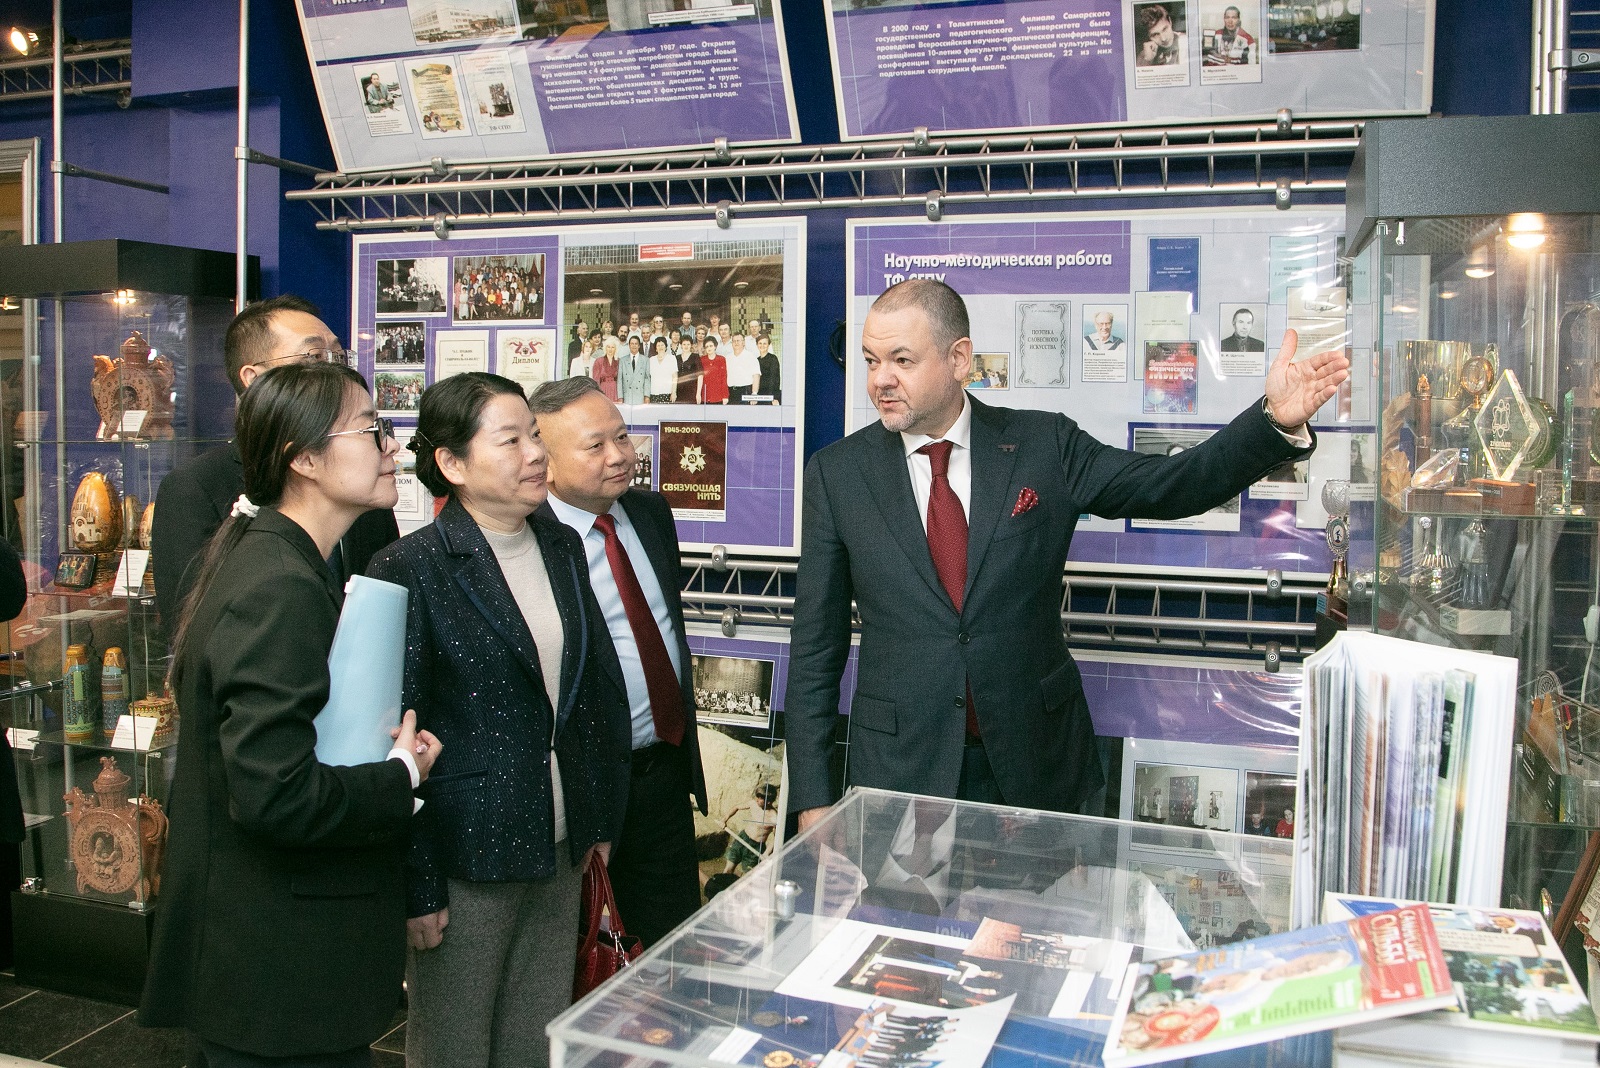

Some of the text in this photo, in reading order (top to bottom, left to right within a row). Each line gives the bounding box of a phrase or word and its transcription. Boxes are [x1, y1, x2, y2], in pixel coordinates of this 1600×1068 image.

[949, 18, 1004, 27] Тольяттинском
[1020, 14, 1055, 24] филиале
[1063, 11, 1110, 20] Самарского
[876, 32, 940, 42] государственного
[949, 27, 1012, 37] педагогического
[1027, 22, 1080, 32] университета
[627, 46, 656, 55] декабре
[702, 40, 736, 48] Открытие
[876, 29, 1111, 52] проведена Всероссийская научно-практическая конференция,
[964, 46, 1006, 55] факультета
[1012, 42, 1056, 52] физической
[1059, 40, 1098, 48] культуры.
[540, 62, 587, 70] гуманитарного
[638, 52, 683, 62] потребностям
[554, 70, 587, 78] начинался
[600, 66, 640, 74] факультетов
[650, 60, 692, 70] дошкольной
[694, 58, 731, 66] педагогики
[878, 60, 929, 69] конференции
[936, 57, 976, 65] выступили
[1001, 52, 1055, 62] докладчиков,
[544, 78, 582, 86] психологии,
[589, 76, 618, 84] русского
[662, 68, 704, 76] литературы,
[710, 66, 739, 74] физико-
[880, 64, 1006, 78] подготовили сотрудники филиала.
[546, 86, 602, 94] математического,
[606, 80, 665, 90] общетехнических
[669, 76, 706, 85] дисциплин
[718, 74, 740, 82] труда.
[547, 94, 584, 102] Постепенно
[606, 90, 634, 98] открыты
[660, 84, 705, 94] факультетов.
[574, 100, 609, 108] подготовил
[610, 98, 629, 106] более
[654, 94, 699, 102] специалистов
[884, 249, 1112, 272] Научно-методическая работа
[884, 273, 905, 288] ТФ
[512, 356, 540, 365] Диплом
[664, 426, 700, 434] 1945-2000
[697, 492, 721, 500] НИТЬ
